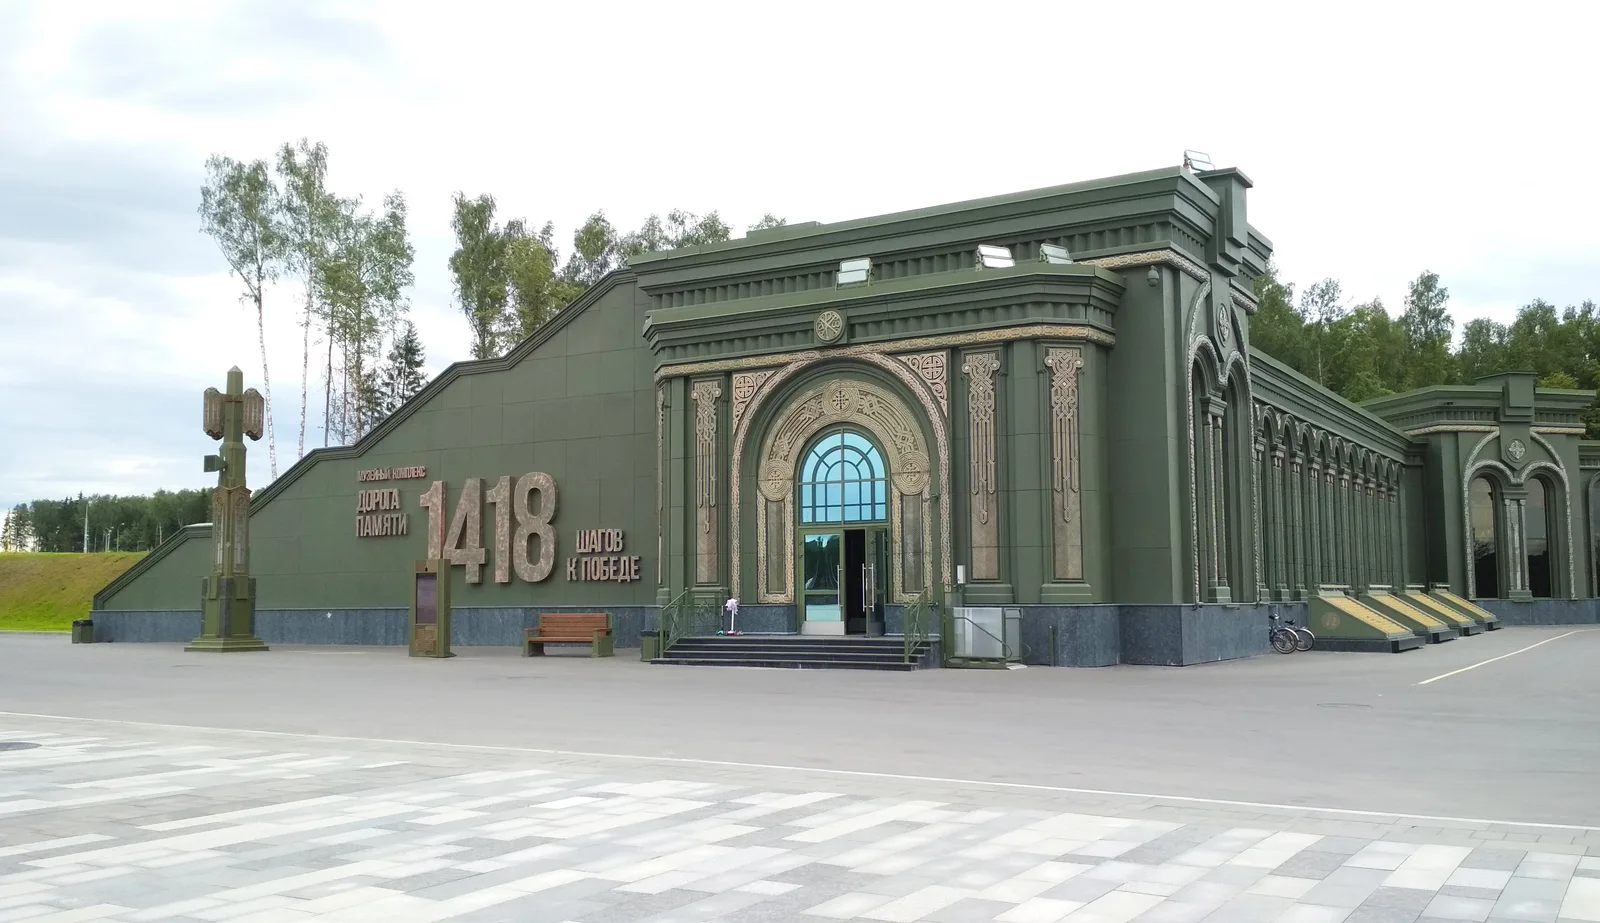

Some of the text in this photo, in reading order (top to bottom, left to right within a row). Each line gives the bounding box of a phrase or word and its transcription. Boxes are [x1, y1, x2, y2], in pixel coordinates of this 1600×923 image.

[356, 488, 400, 513] ДОРОГА
[356, 513, 407, 537] ПАМЯТИ
[420, 472, 557, 583] 1418
[576, 528, 623, 553] ШАГОВ
[566, 555, 640, 582] К ПОБЕДЕ
